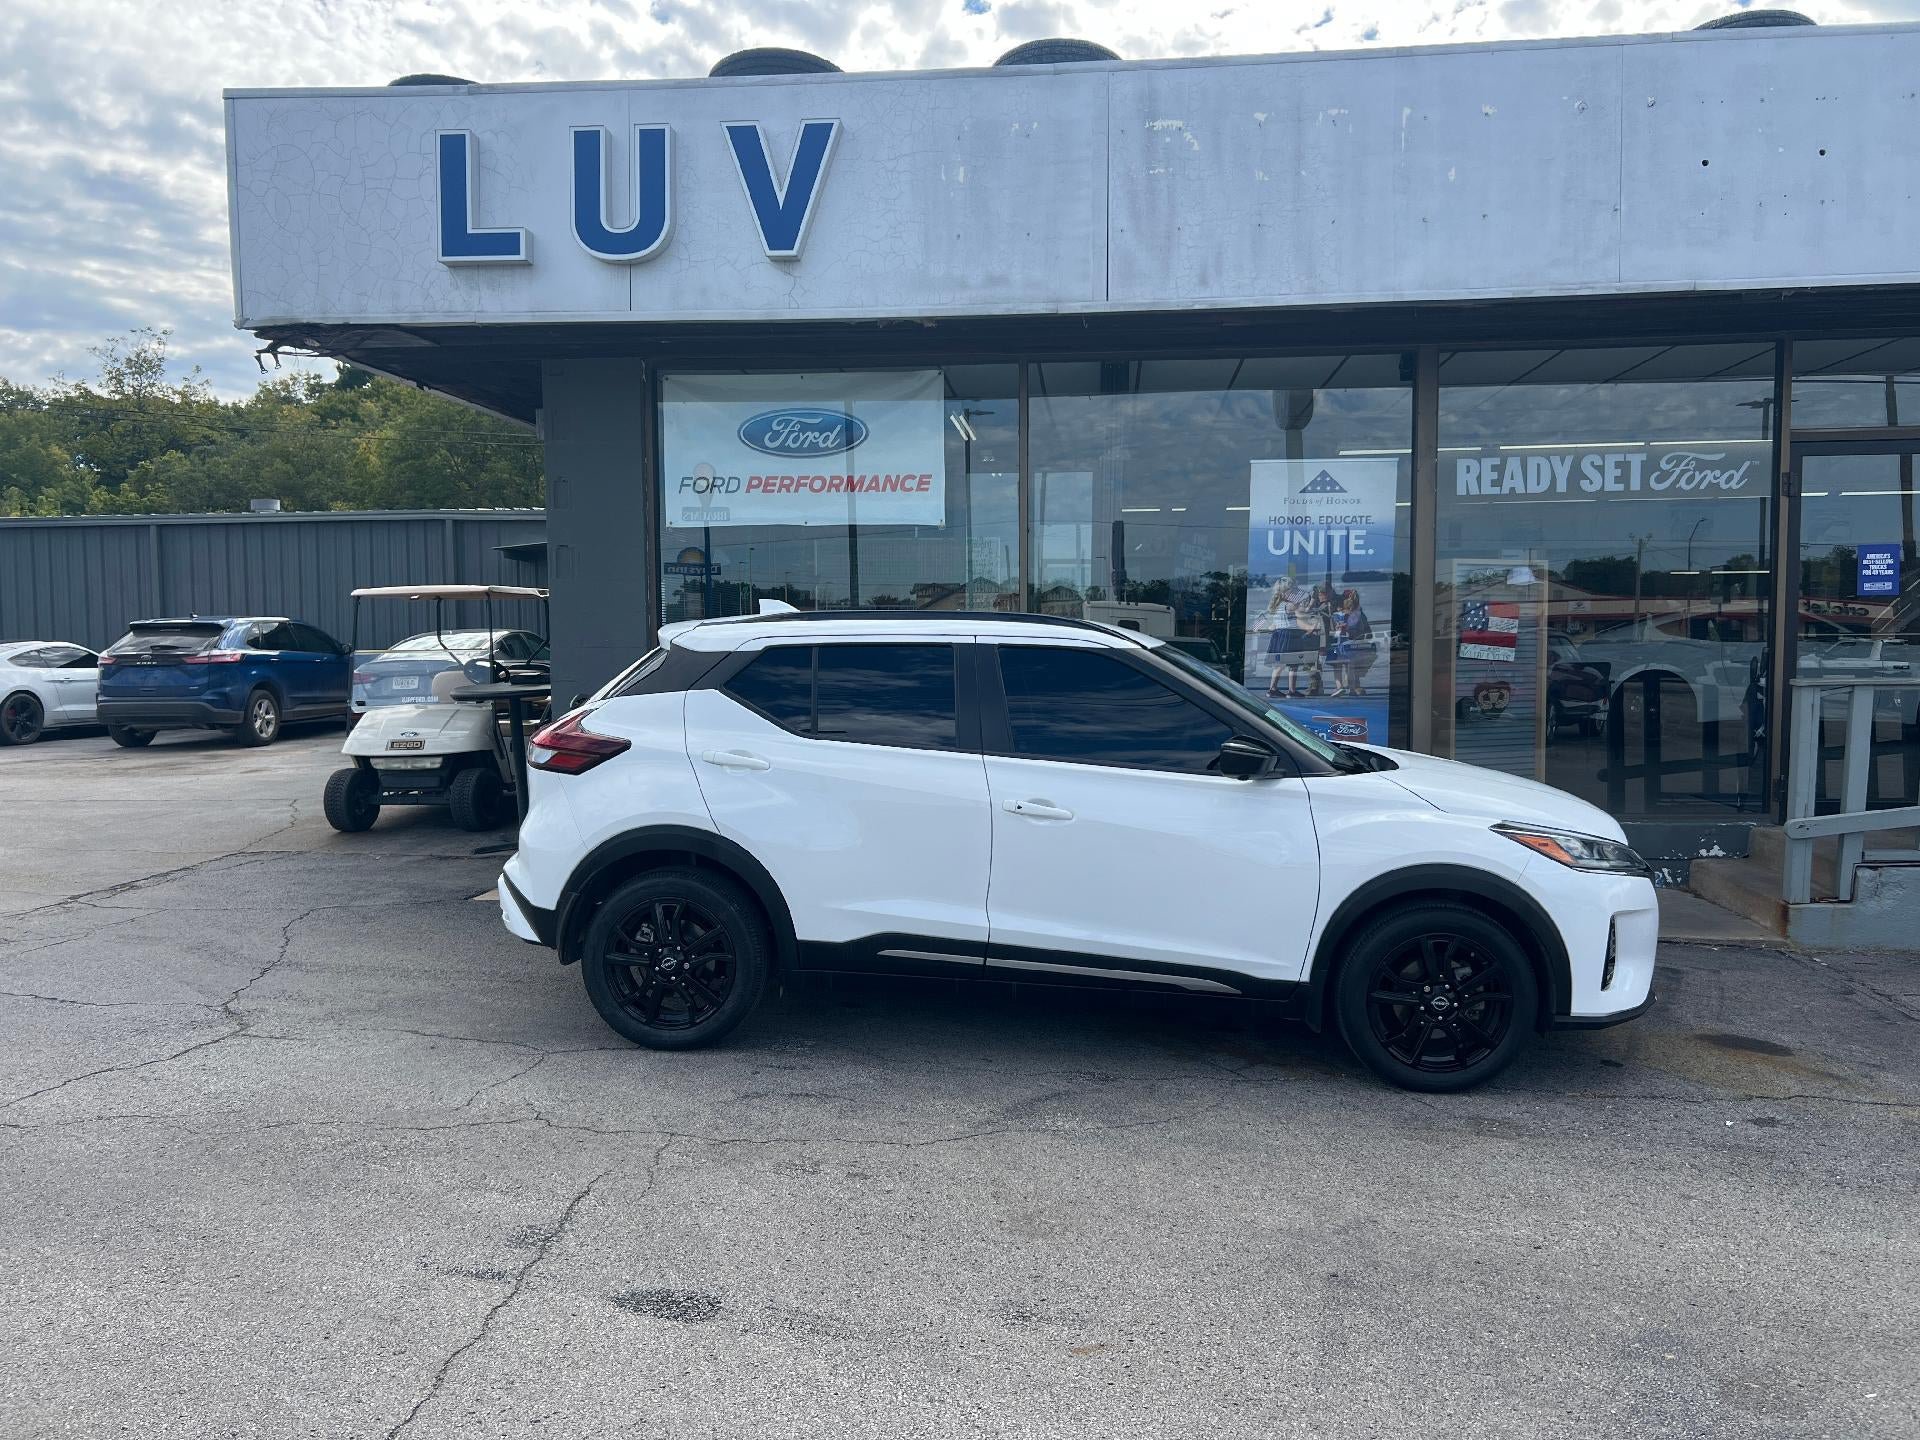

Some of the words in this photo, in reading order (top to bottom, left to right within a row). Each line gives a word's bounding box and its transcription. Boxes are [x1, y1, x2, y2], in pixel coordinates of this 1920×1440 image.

[763, 415, 843, 449] Ford
[678, 476, 741, 495] FORD
[745, 474, 933, 494] PERFORMANCE
[1456, 454, 1573, 496] READY
[1580, 453, 1647, 493] SET
[1649, 451, 1751, 491] Ford
[1268, 515, 1315, 525] HONOR.
[1318, 515, 1375, 525] EDUCATE.
[1267, 529, 1375, 555] UNITE.
